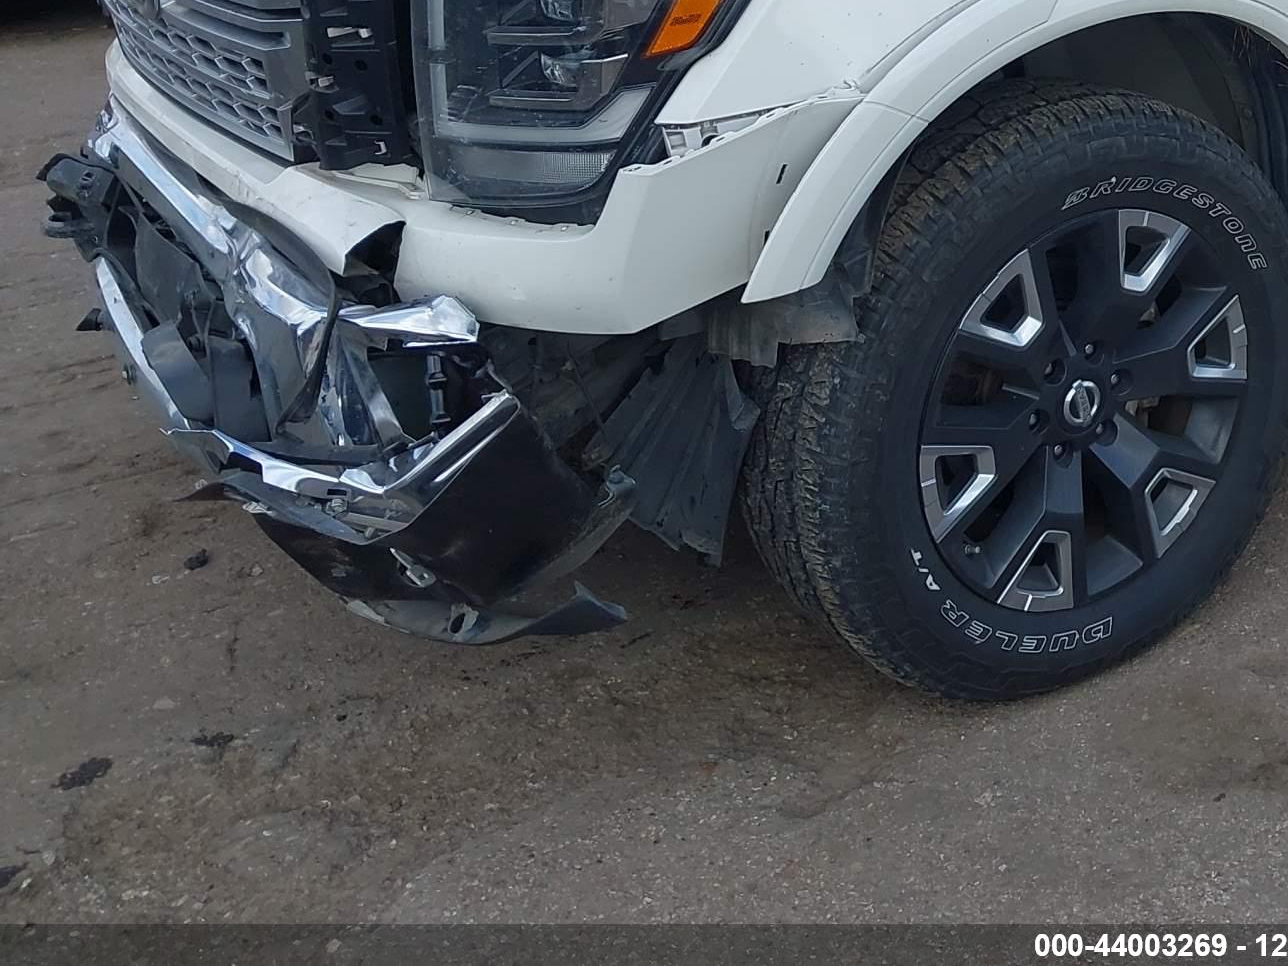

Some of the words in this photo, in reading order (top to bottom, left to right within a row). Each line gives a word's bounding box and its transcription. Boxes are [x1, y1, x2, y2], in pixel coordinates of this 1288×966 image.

[1061, 176, 1268, 271] BRIDGESTONE
[911, 548, 941, 591] A/T
[940, 599, 1114, 654] DUELER
